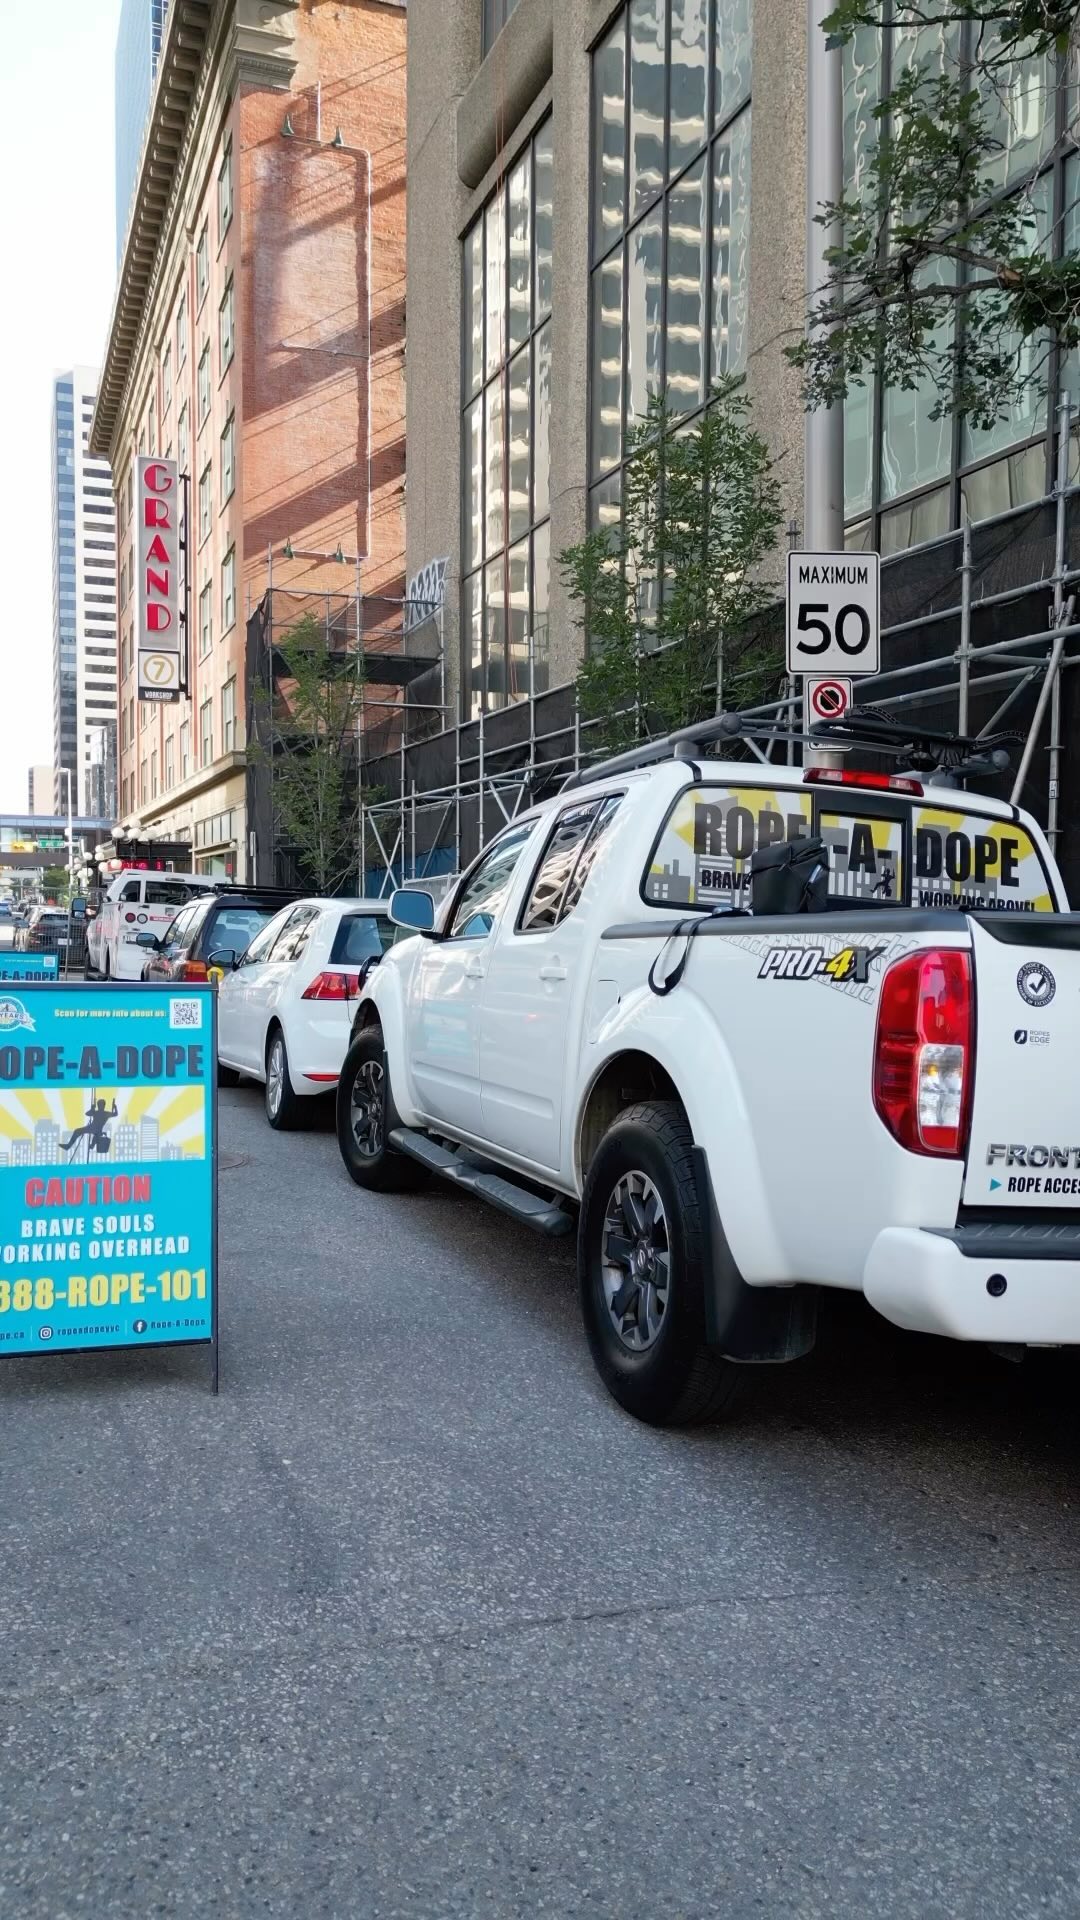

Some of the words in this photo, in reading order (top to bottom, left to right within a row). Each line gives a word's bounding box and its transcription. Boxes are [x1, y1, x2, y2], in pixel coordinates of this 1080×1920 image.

[144, 464, 173, 632] GRAND
[799, 566, 868, 585] MAXIMUM
[796, 603, 871, 655] 50
[152, 661, 167, 682] 7
[144, 690, 173, 699] WORKSHOP
[916, 828, 1019, 887] DOPE
[702, 869, 750, 891] BRAVE
[758, 946, 887, 983] PRO-4X
[0, 971, 55, 981] E-A-DOPE
[55, 1009, 75, 1017] Scan
[77, 1009, 88, 1017] for
[130, 1009, 153, 1017] about
[1030, 1036, 1050, 1044] EDGE
[25, 1175, 151, 1207] CAUTION
[1008, 1177, 1041, 1192] ROPE
[1044, 1178, 1080, 1193] ACCE
[21, 1218, 85, 1238] BRAVE
[93, 1214, 155, 1234] SOULS
[0, 1242, 81, 1264] ORKING
[88, 1236, 190, 1259] OVERHEAD
